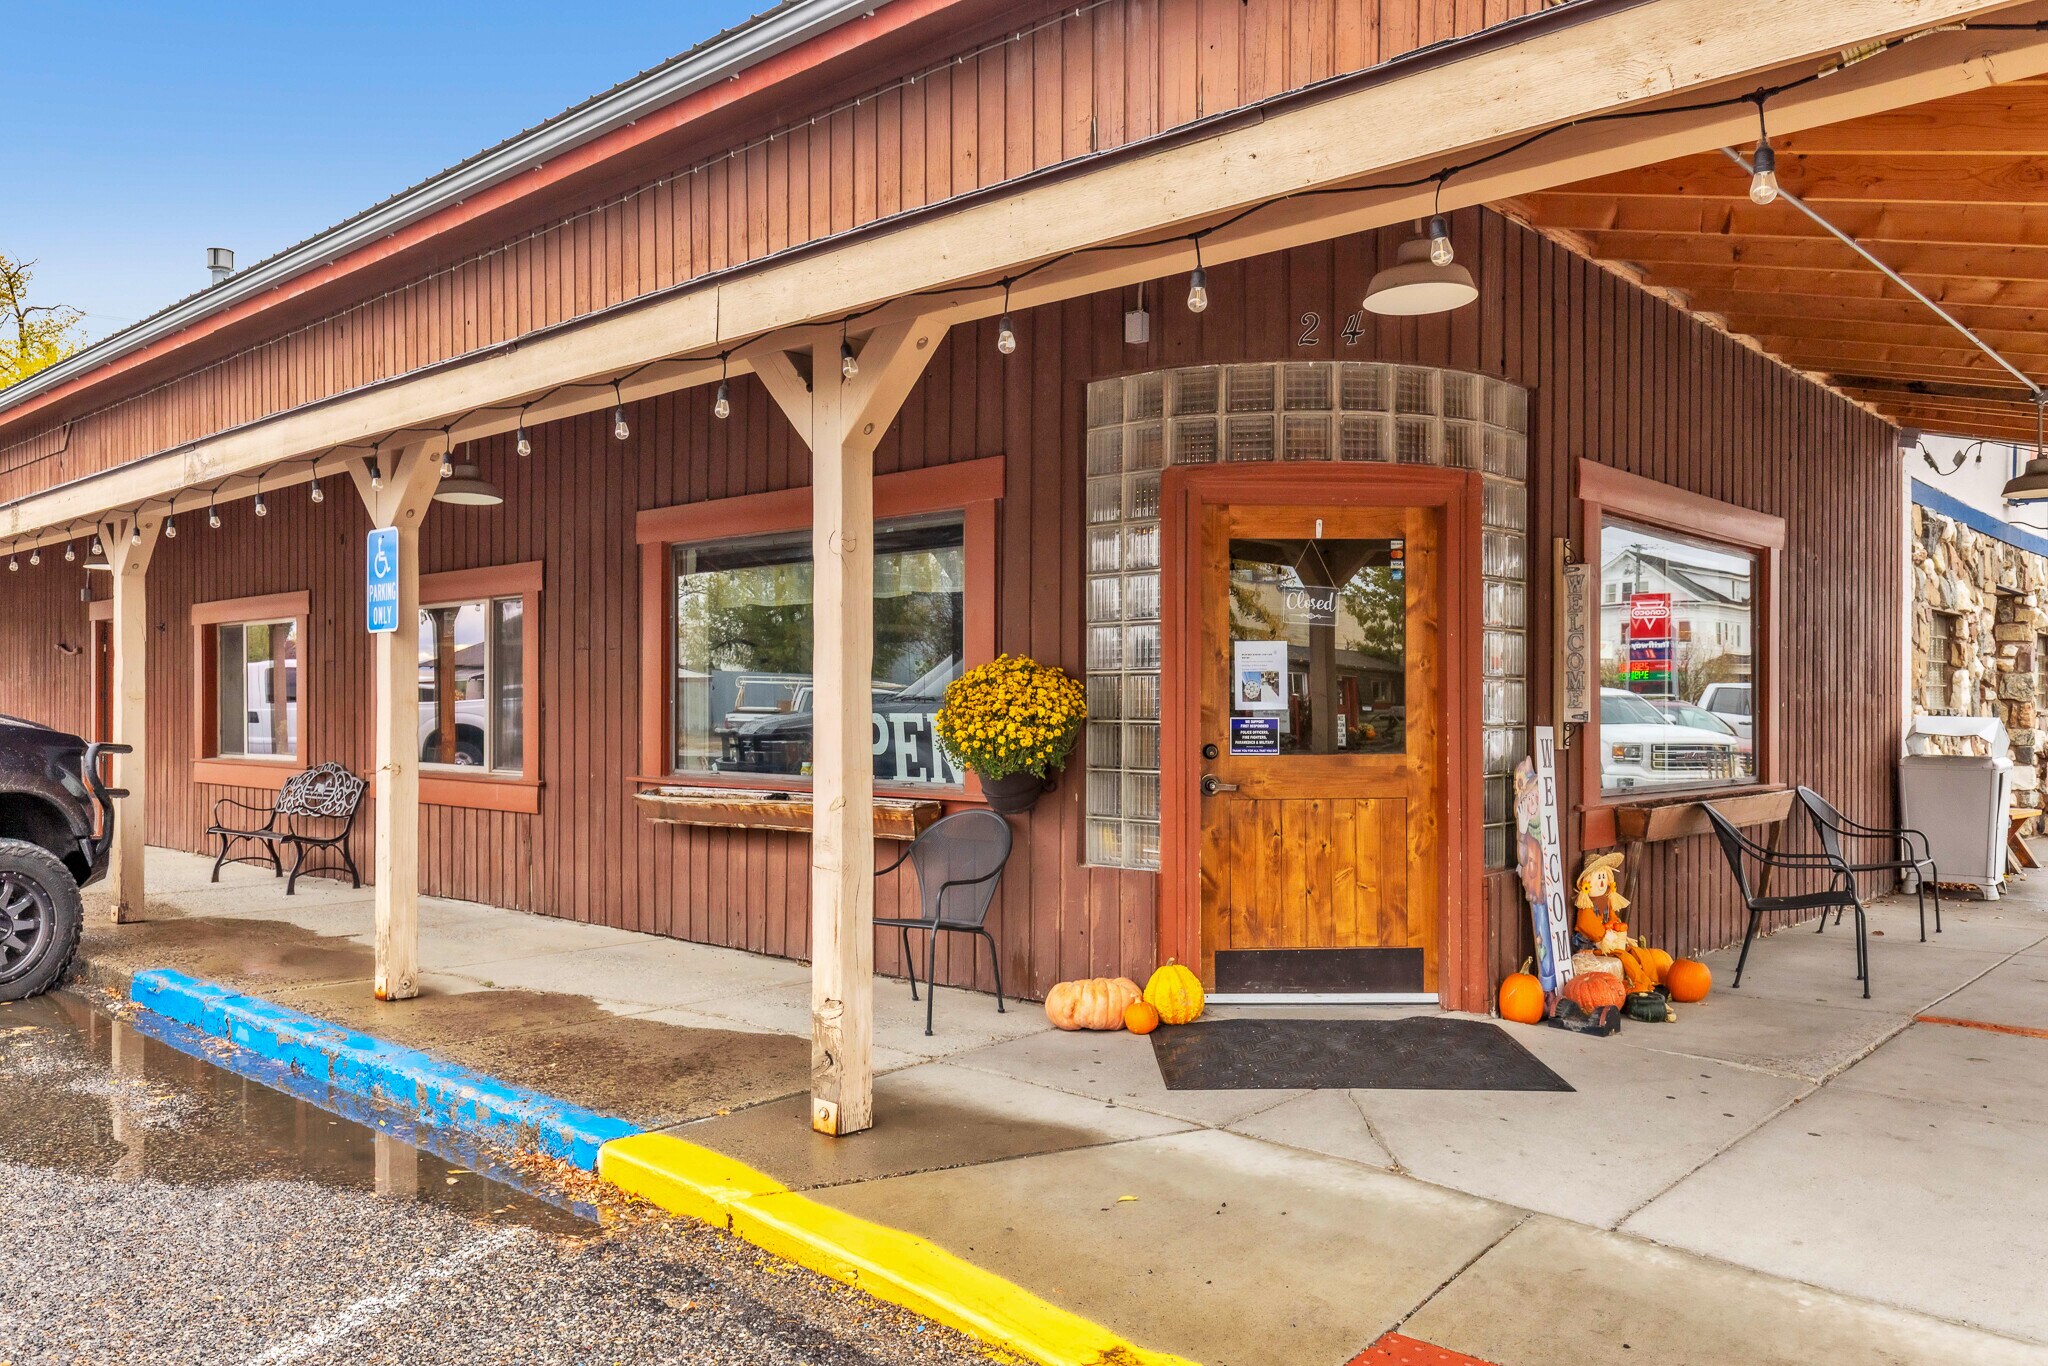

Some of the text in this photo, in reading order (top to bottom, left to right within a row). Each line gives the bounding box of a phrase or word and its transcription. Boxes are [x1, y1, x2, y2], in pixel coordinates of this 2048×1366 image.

[369, 582, 396, 602] PARKING
[1286, 590, 1337, 612] Closed
[373, 605, 392, 625] ONLY
[1565, 574, 1586, 709] WELCOME
[872, 712, 965, 785] PEN
